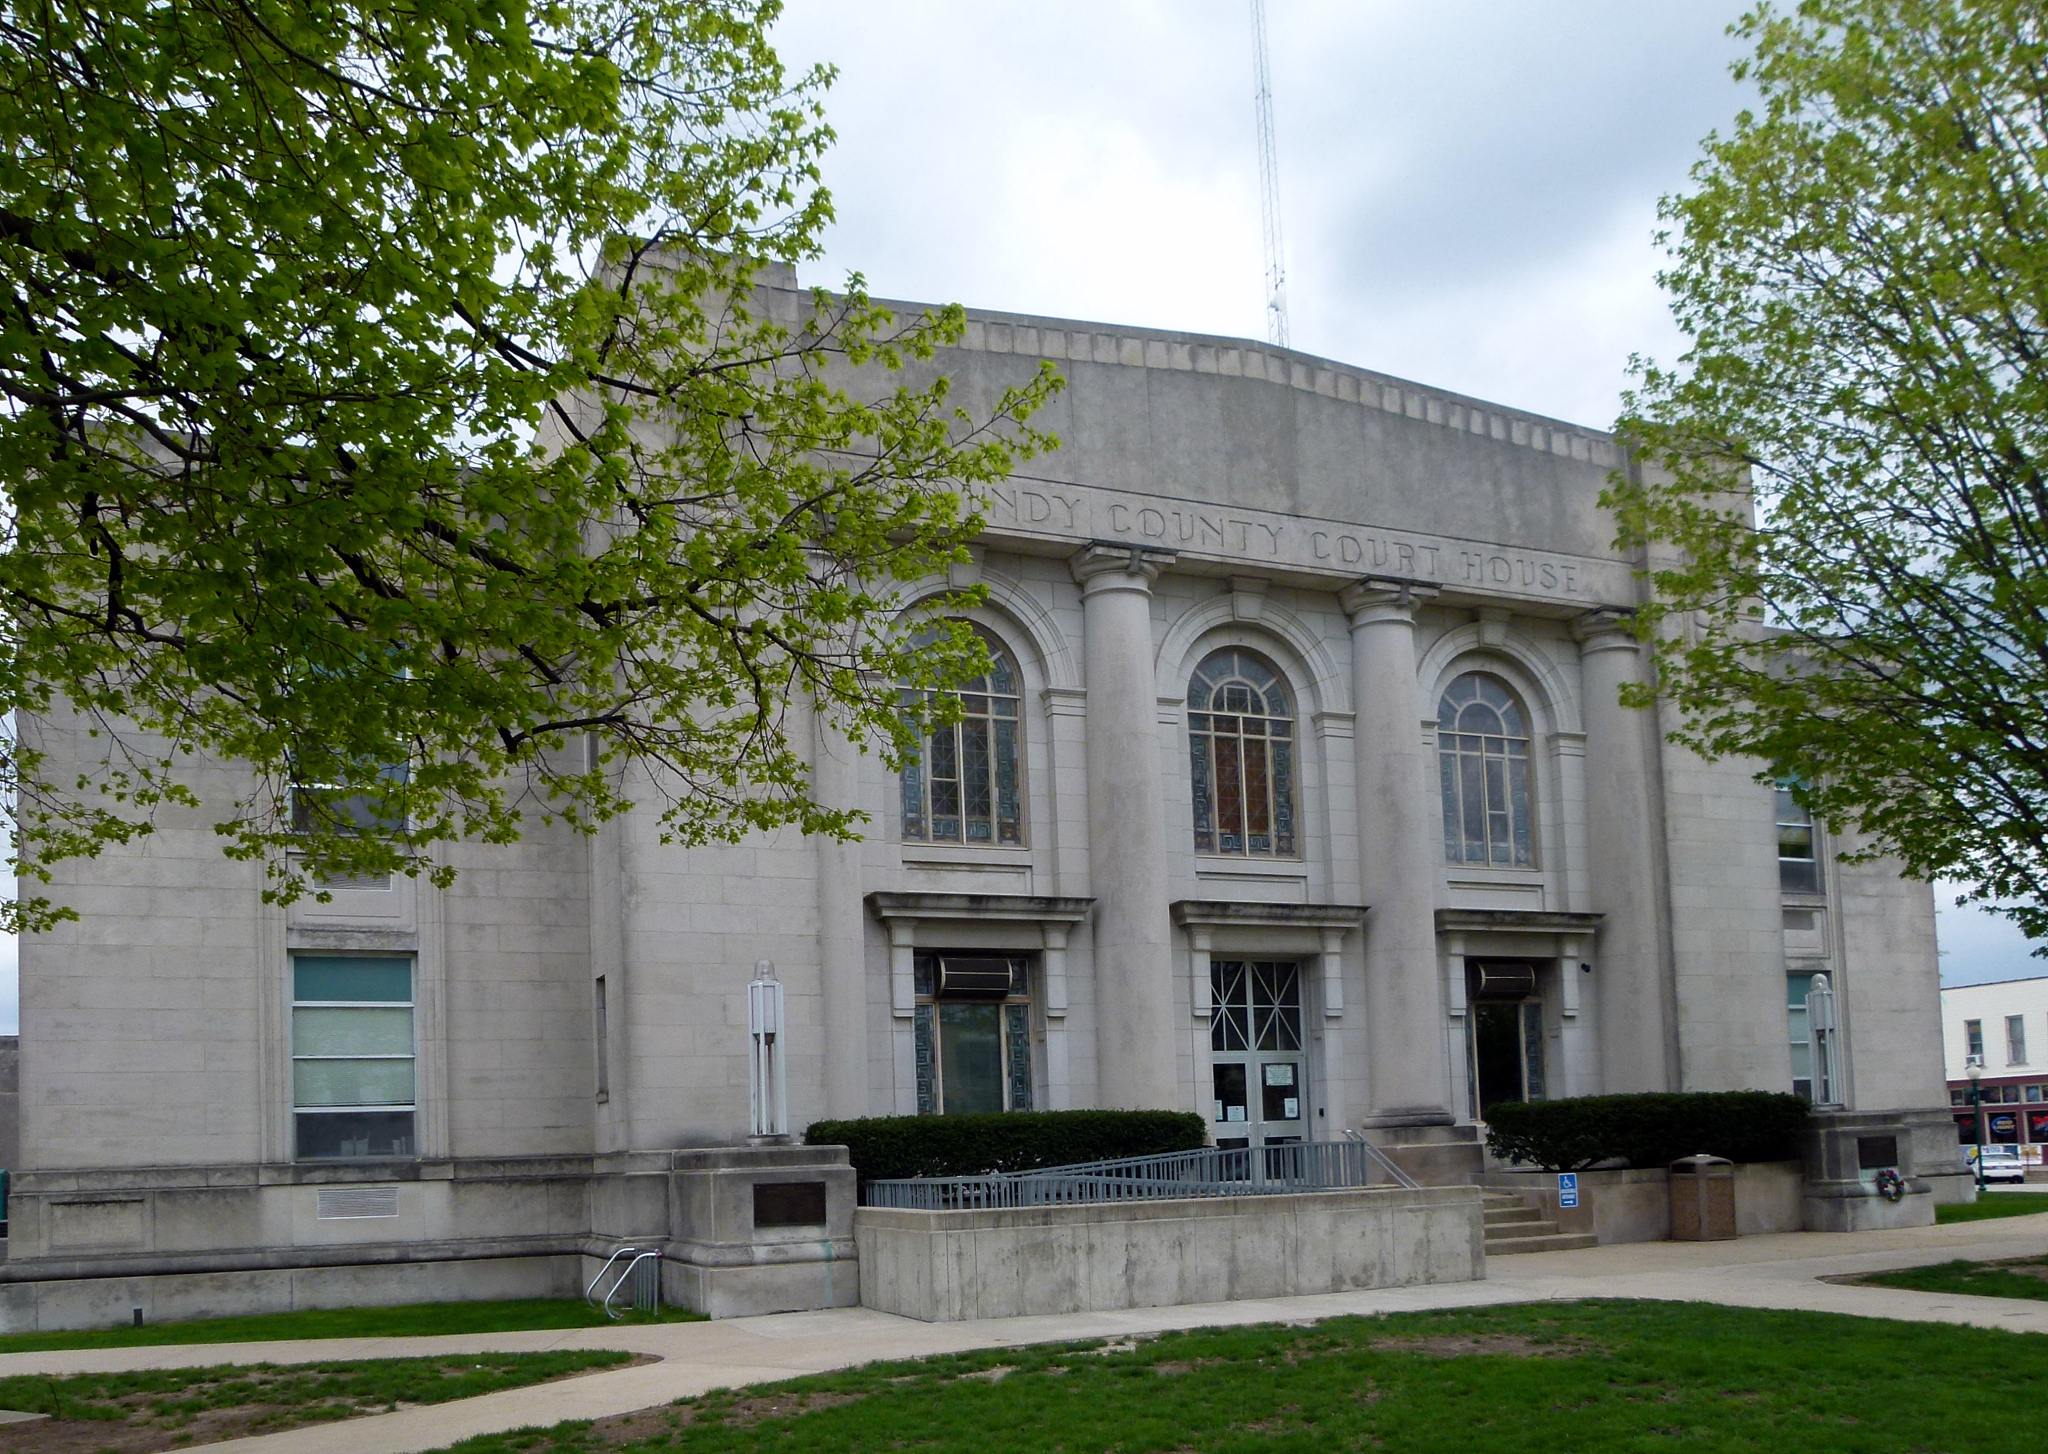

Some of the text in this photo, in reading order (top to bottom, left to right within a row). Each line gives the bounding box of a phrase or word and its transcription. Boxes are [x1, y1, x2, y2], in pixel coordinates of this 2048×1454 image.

[1108, 504, 1283, 555] COUNTY
[1310, 531, 1439, 575] COURT
[1460, 551, 1577, 592] HOUSE
